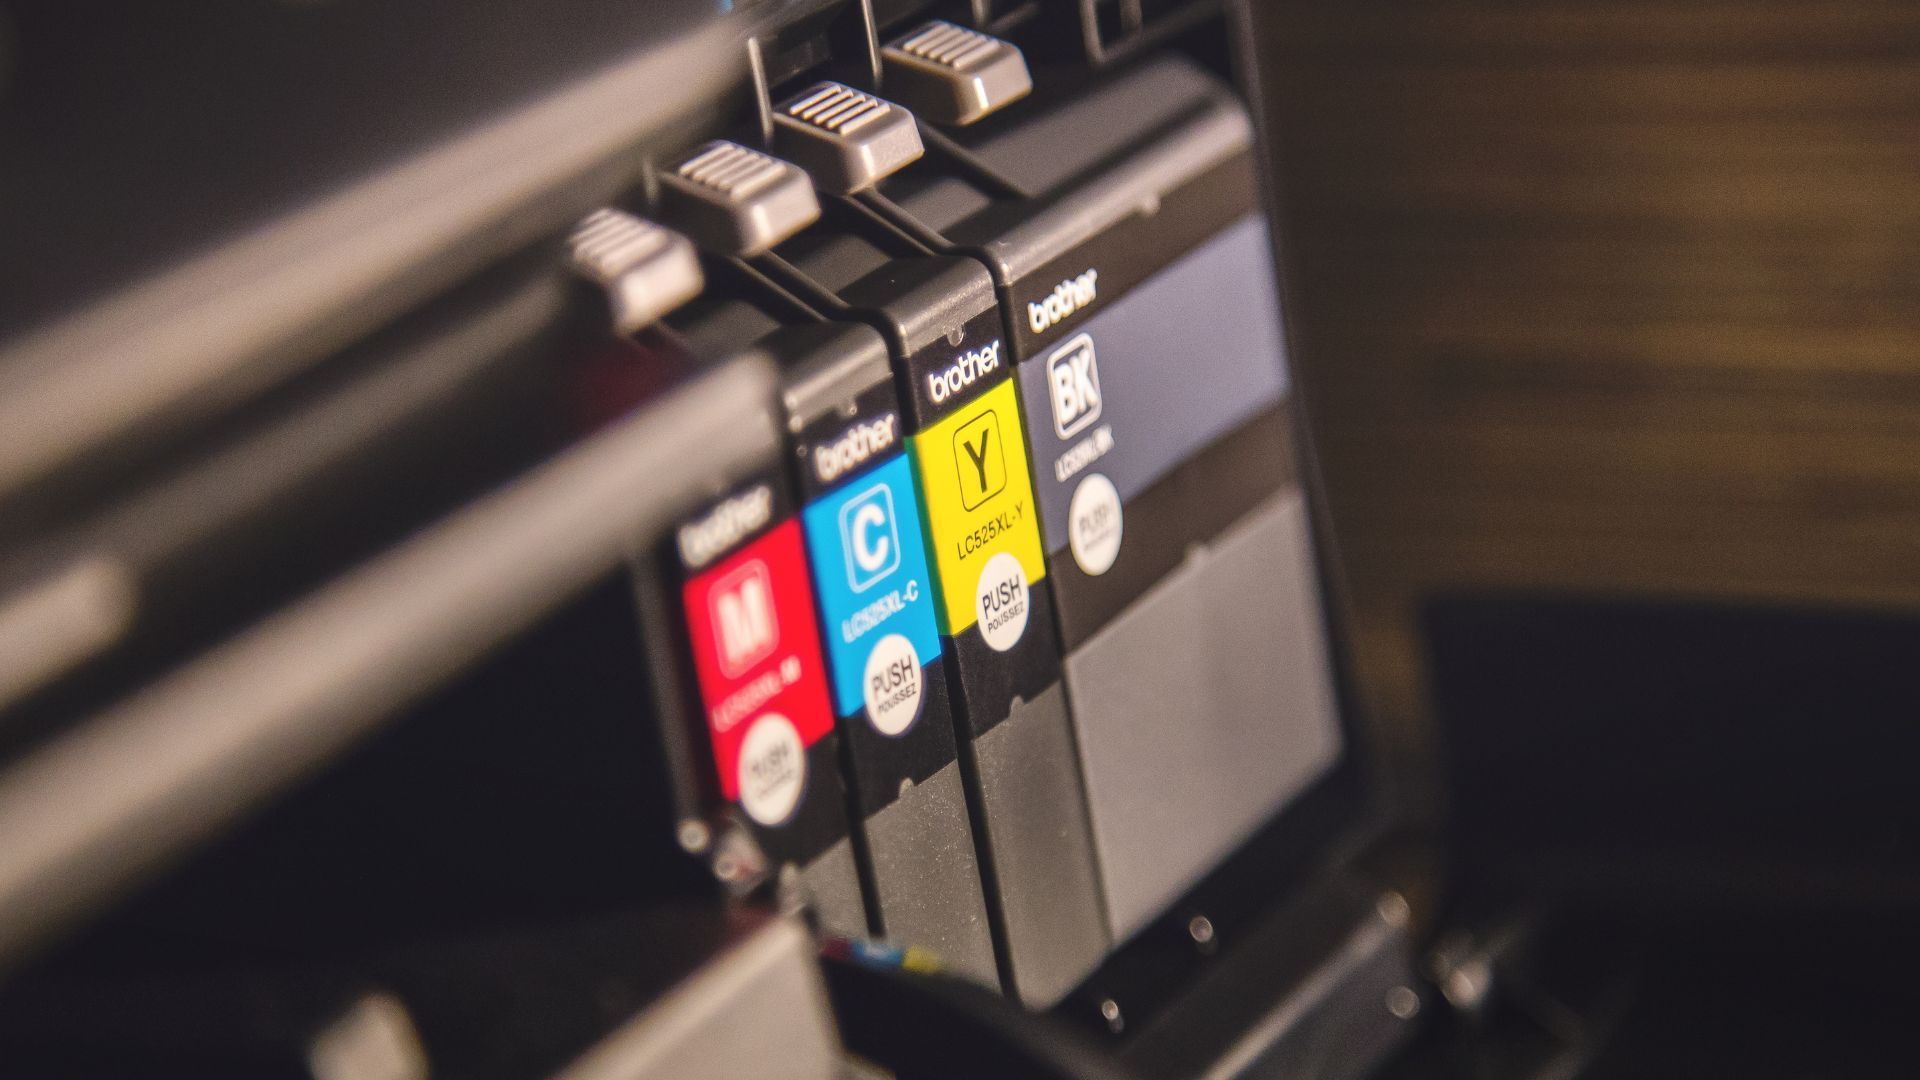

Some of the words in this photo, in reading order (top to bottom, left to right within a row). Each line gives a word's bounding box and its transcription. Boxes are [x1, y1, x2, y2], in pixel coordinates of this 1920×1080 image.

[1028, 268, 1097, 333] brother
[929, 340, 999, 402] brother
[1054, 349, 1099, 424] BK
[815, 413, 894, 482] brother
[963, 428, 989, 493] Y
[853, 503, 888, 571] C
[957, 501, 1023, 560] LC525XL-Y
[717, 577, 772, 664] M
[982, 574, 1022, 620] PUSH
[988, 602, 1024, 634] POUSSEZ
[873, 655, 913, 701] PUSH
